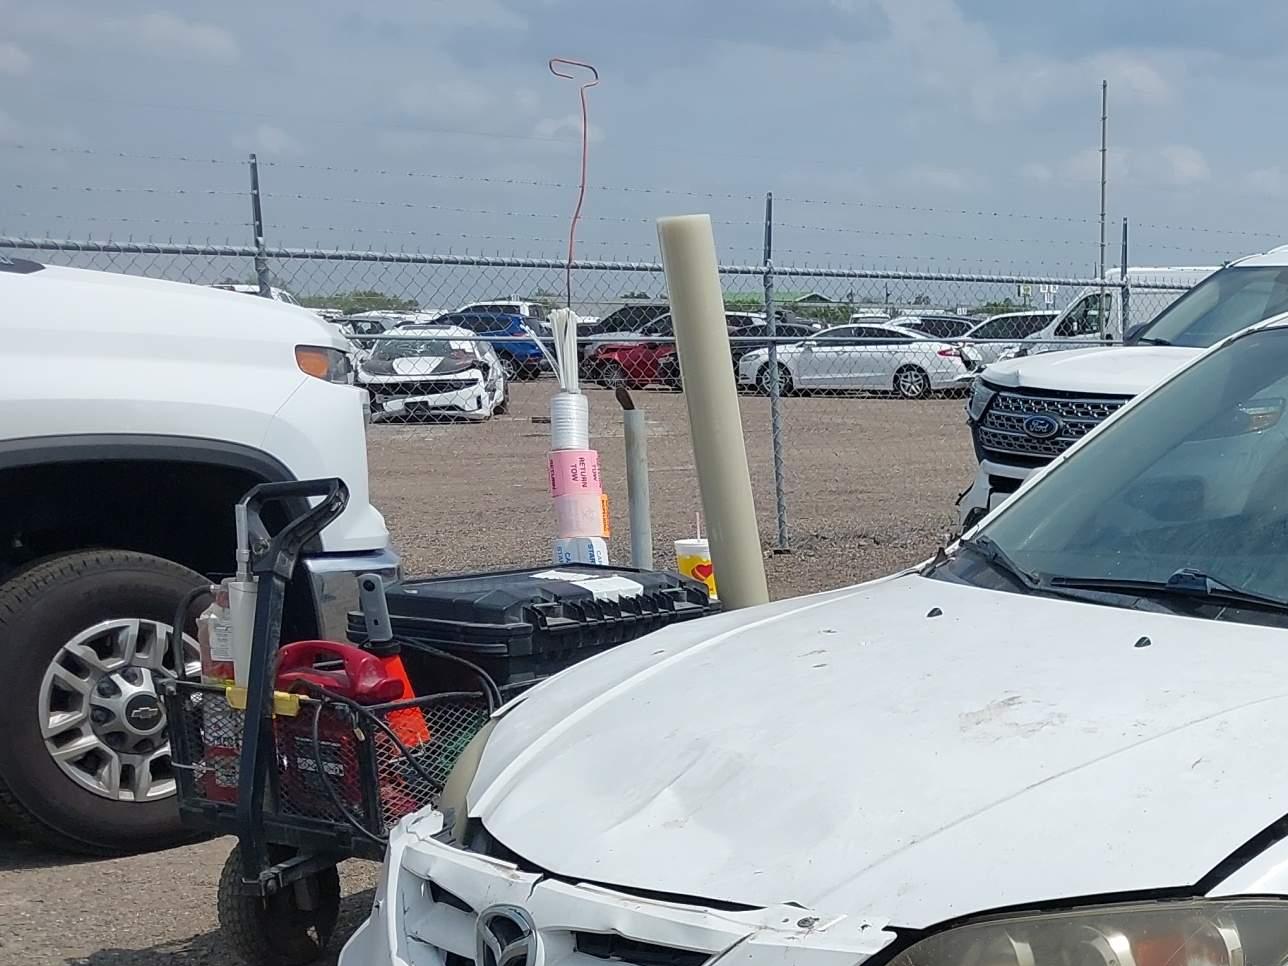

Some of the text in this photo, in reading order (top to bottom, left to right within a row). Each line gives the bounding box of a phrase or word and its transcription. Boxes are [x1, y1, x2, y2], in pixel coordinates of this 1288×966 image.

[1029, 419, 1049, 432] Ford
[570, 464, 579, 482] TOW
[578, 457, 589, 488] RETURN
